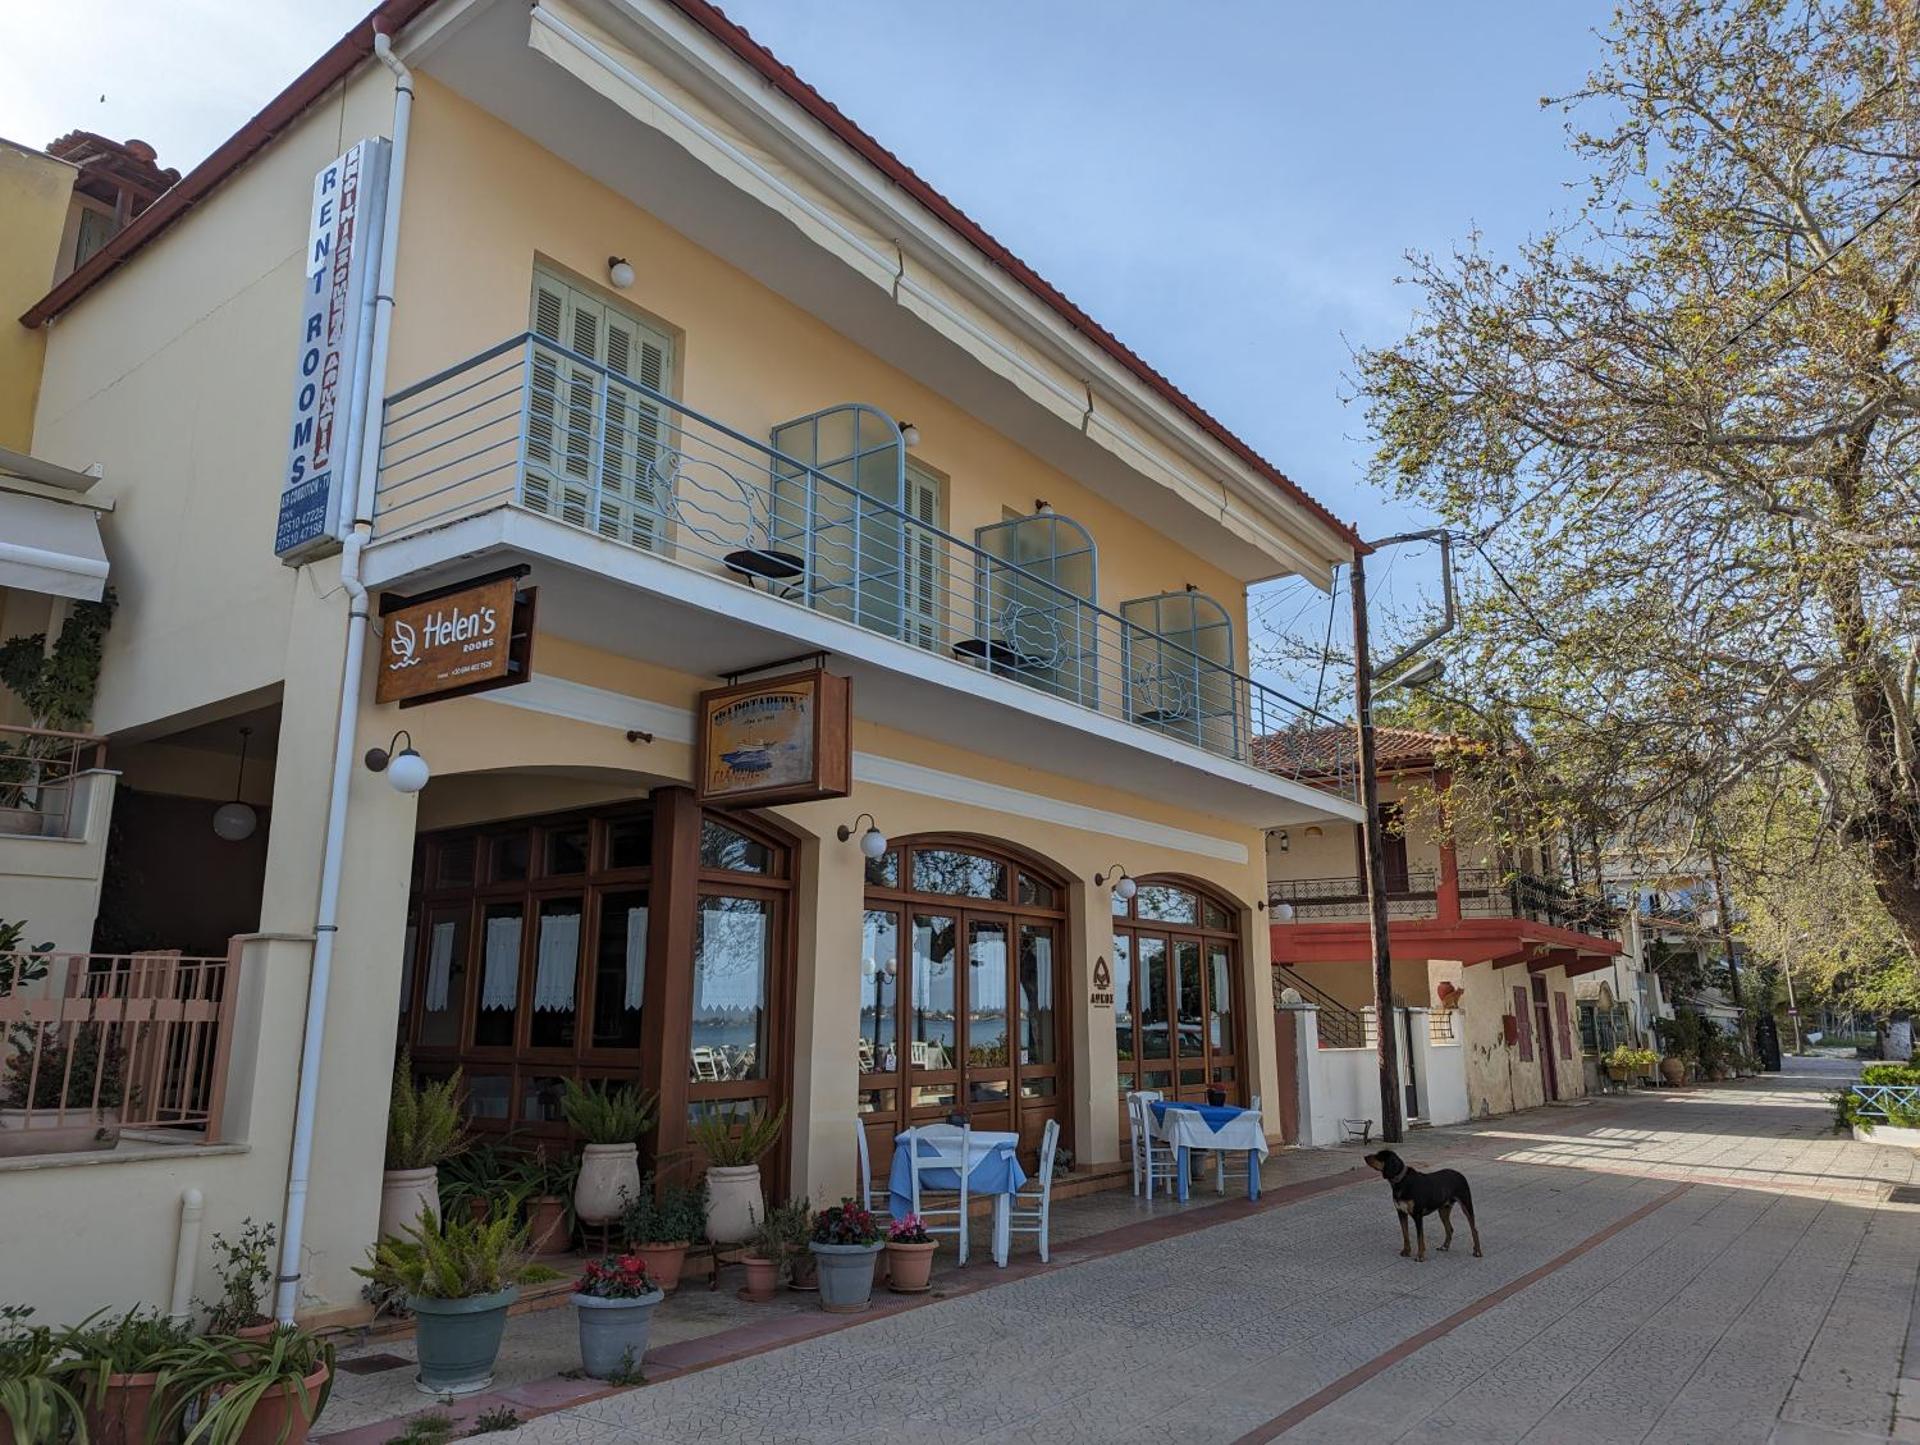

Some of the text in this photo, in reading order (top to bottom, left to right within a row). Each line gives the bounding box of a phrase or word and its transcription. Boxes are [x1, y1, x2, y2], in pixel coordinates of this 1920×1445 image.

[290, 167, 337, 485] RENT ROOMS
[279, 505, 325, 536] 27510 47225
[277, 530, 299, 552] 27510
[423, 607, 495, 649] Helen's
[463, 638, 495, 653] ROOMS
